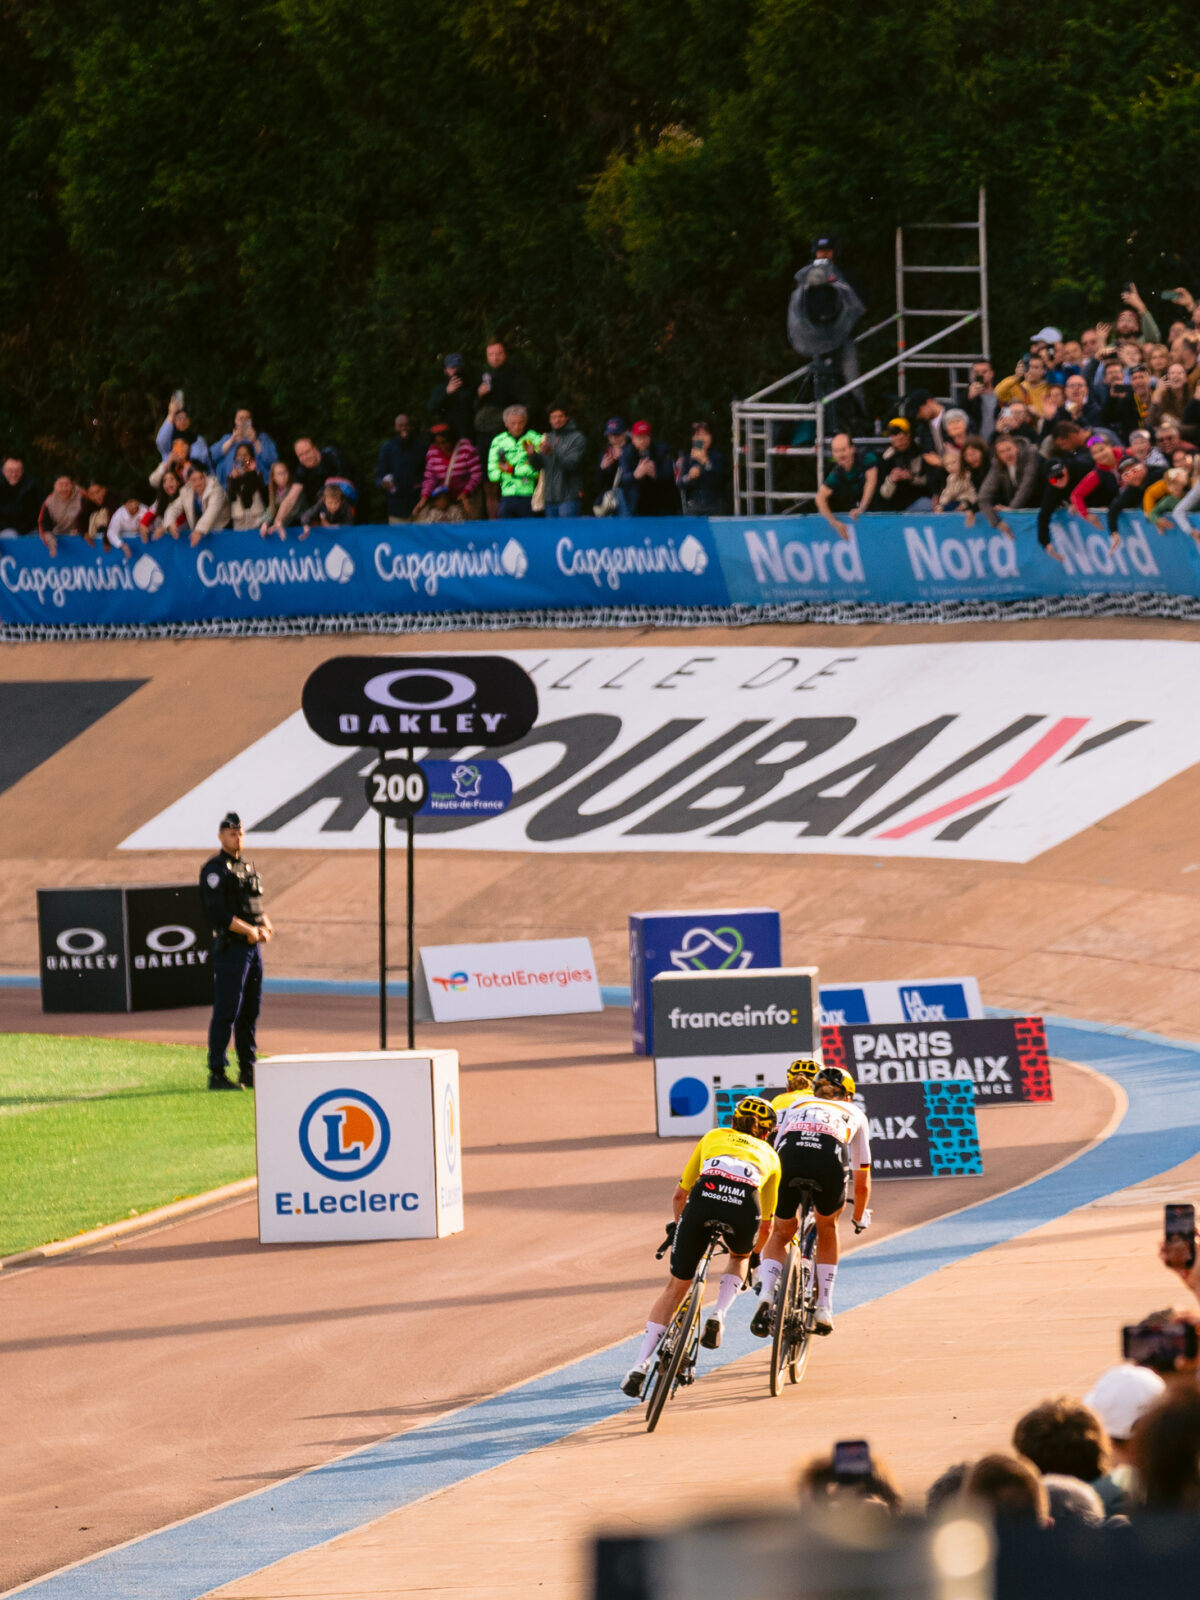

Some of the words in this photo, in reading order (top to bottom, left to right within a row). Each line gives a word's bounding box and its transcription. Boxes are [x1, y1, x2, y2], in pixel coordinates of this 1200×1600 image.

[744, 523, 865, 583] Nord
[903, 526, 1020, 582] Nord
[1050, 520, 1160, 577] Nord
[197, 548, 326, 601] Capgemini
[374, 542, 503, 597] Capgemini
[556, 536, 681, 590] Capgemini
[1, 555, 134, 607] Capgemini
[527, 657, 716, 692] ILLE
[740, 657, 860, 692] DE
[338, 713, 502, 734] OAKLEY
[372, 774, 424, 803] 200
[431, 799, 504, 810] Hauts-de-France
[46, 954, 119, 970] OAKLEY
[134, 951, 208, 969] OAKLEY
[473, 967, 593, 988] TotalEnergies
[903, 990, 923, 1009] LA
[668, 1004, 798, 1029] franceinfo:
[820, 1009, 847, 1024] OIX
[852, 1031, 953, 1060] PARIS
[856, 1056, 1012, 1084] ROUBAIX
[874, 1157, 924, 1170] RANCE
[275, 1190, 419, 1215] E.Leclerc
[718, 1184, 746, 1198] VISMA
